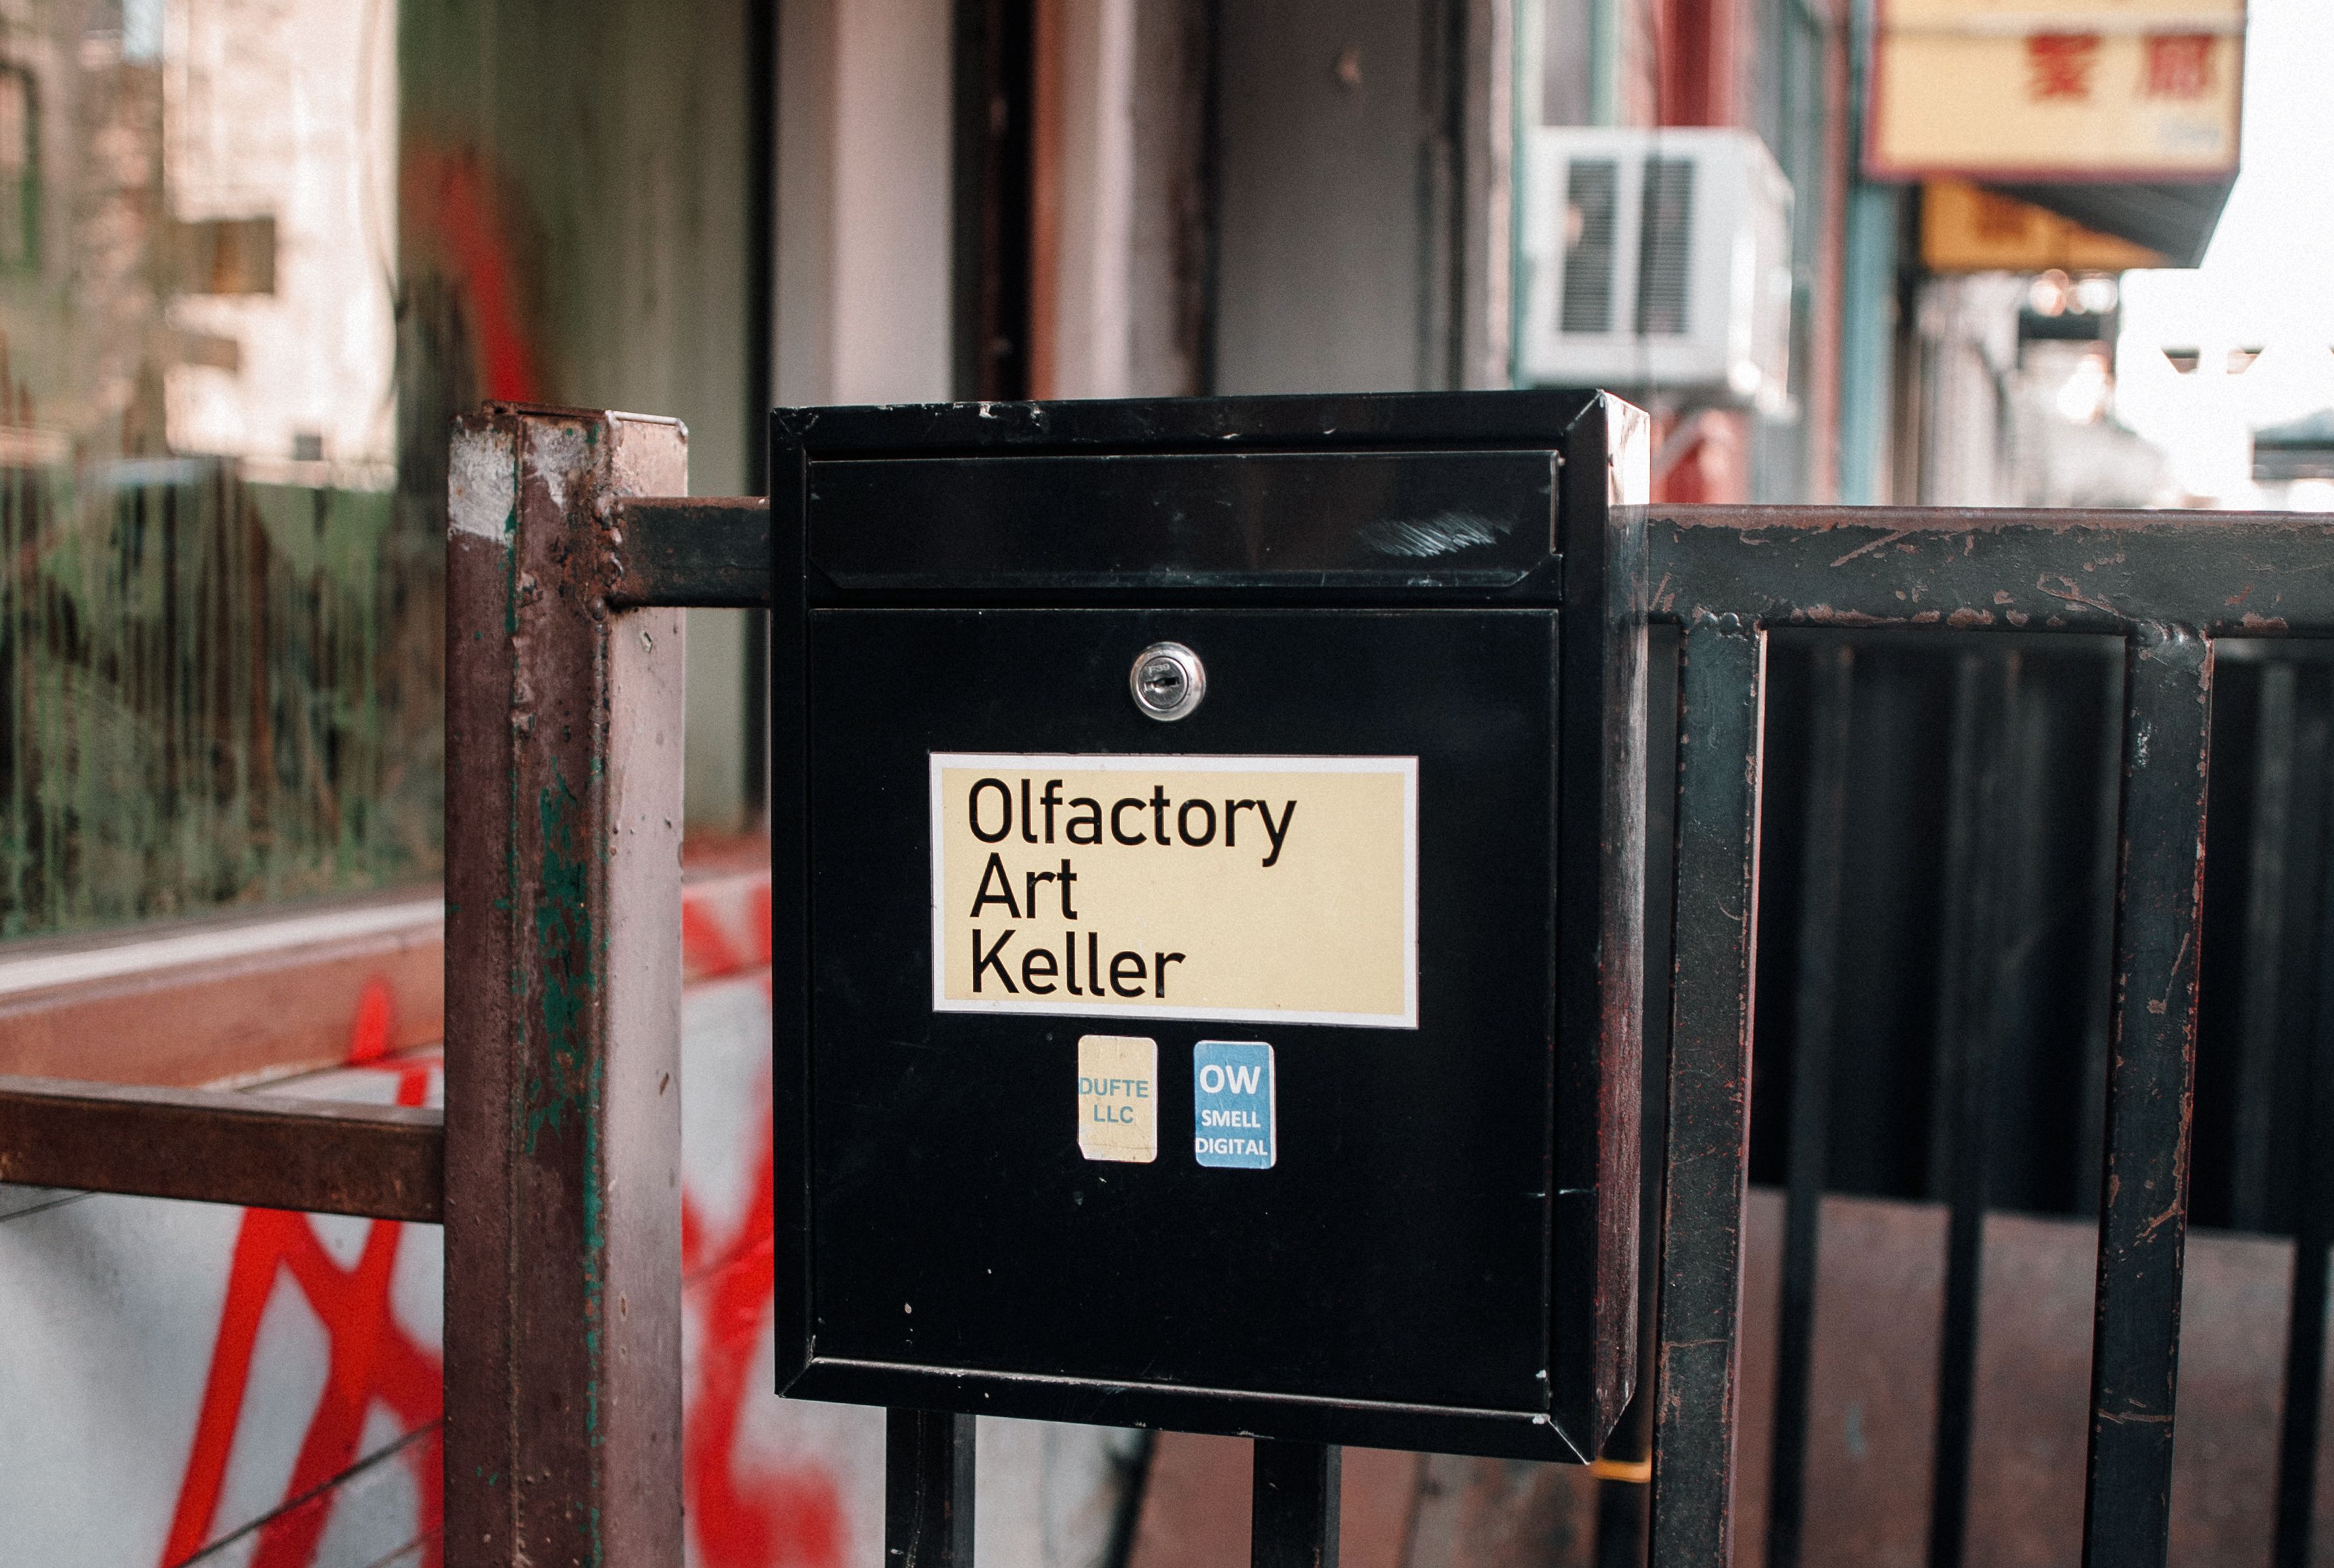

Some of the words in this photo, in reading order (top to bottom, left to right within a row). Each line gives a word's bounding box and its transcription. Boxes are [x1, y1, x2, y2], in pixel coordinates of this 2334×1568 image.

[968, 778, 1297, 868] Olfactory
[970, 852, 1078, 920] Art
[972, 929, 1186, 998] Keller
[1079, 1077, 1149, 1098] DUFTE
[1199, 1064, 1261, 1094] OW
[1093, 1105, 1134, 1123] LLC
[1201, 1110, 1261, 1128] SMELL
[1196, 1137, 1268, 1156] DIGITAL
